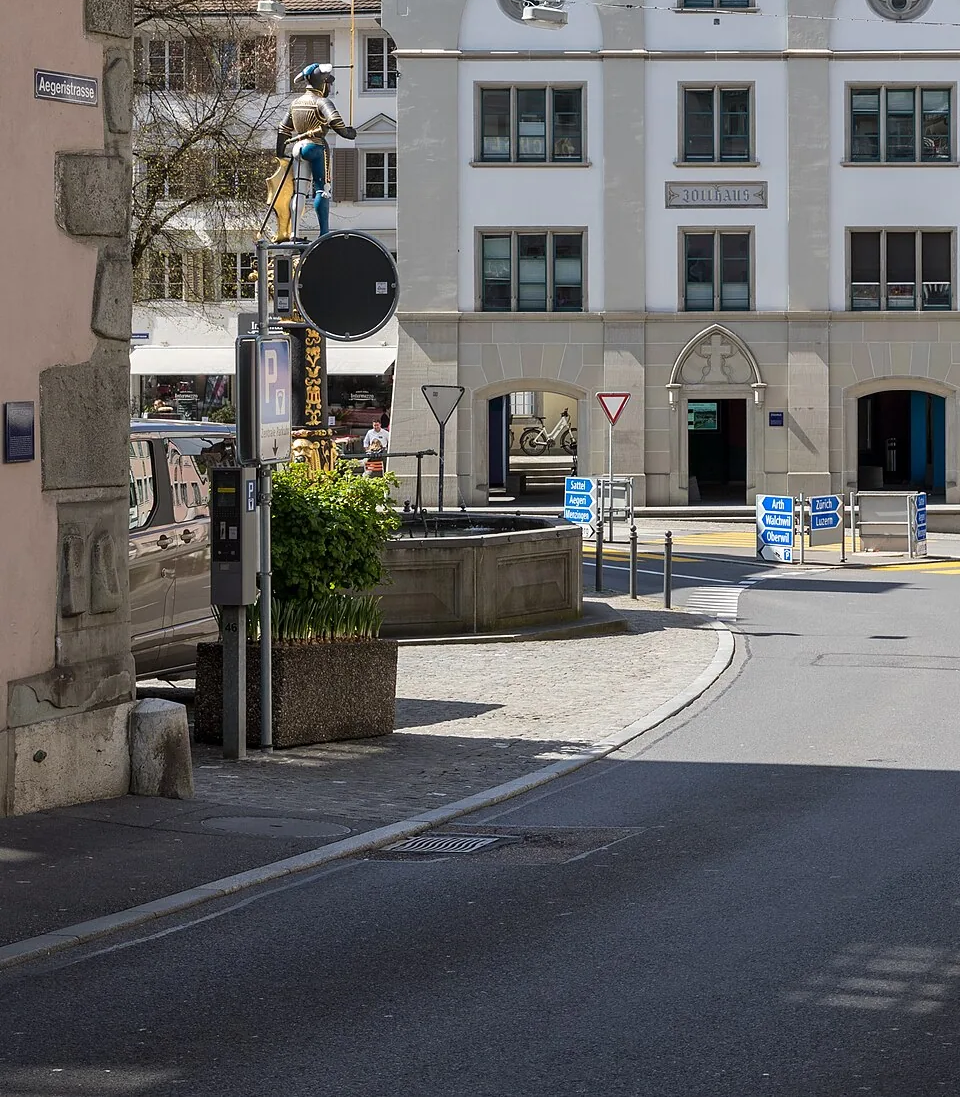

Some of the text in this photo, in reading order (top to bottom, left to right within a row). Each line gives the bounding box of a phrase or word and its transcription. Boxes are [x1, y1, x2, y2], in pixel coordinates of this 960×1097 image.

[39, 76, 95, 99] Aegeristrasse
[264, 349, 278, 404] P
[248, 482, 254, 498] P
[570, 480, 586, 490] Sattel
[569, 495, 587, 507] Aegeri
[771, 499, 785, 510] Arth
[816, 498, 833, 510] Zürich
[765, 515, 791, 527] Walchwil
[815, 516, 834, 526] Luzern
[766, 531, 790, 543] Oberwil
